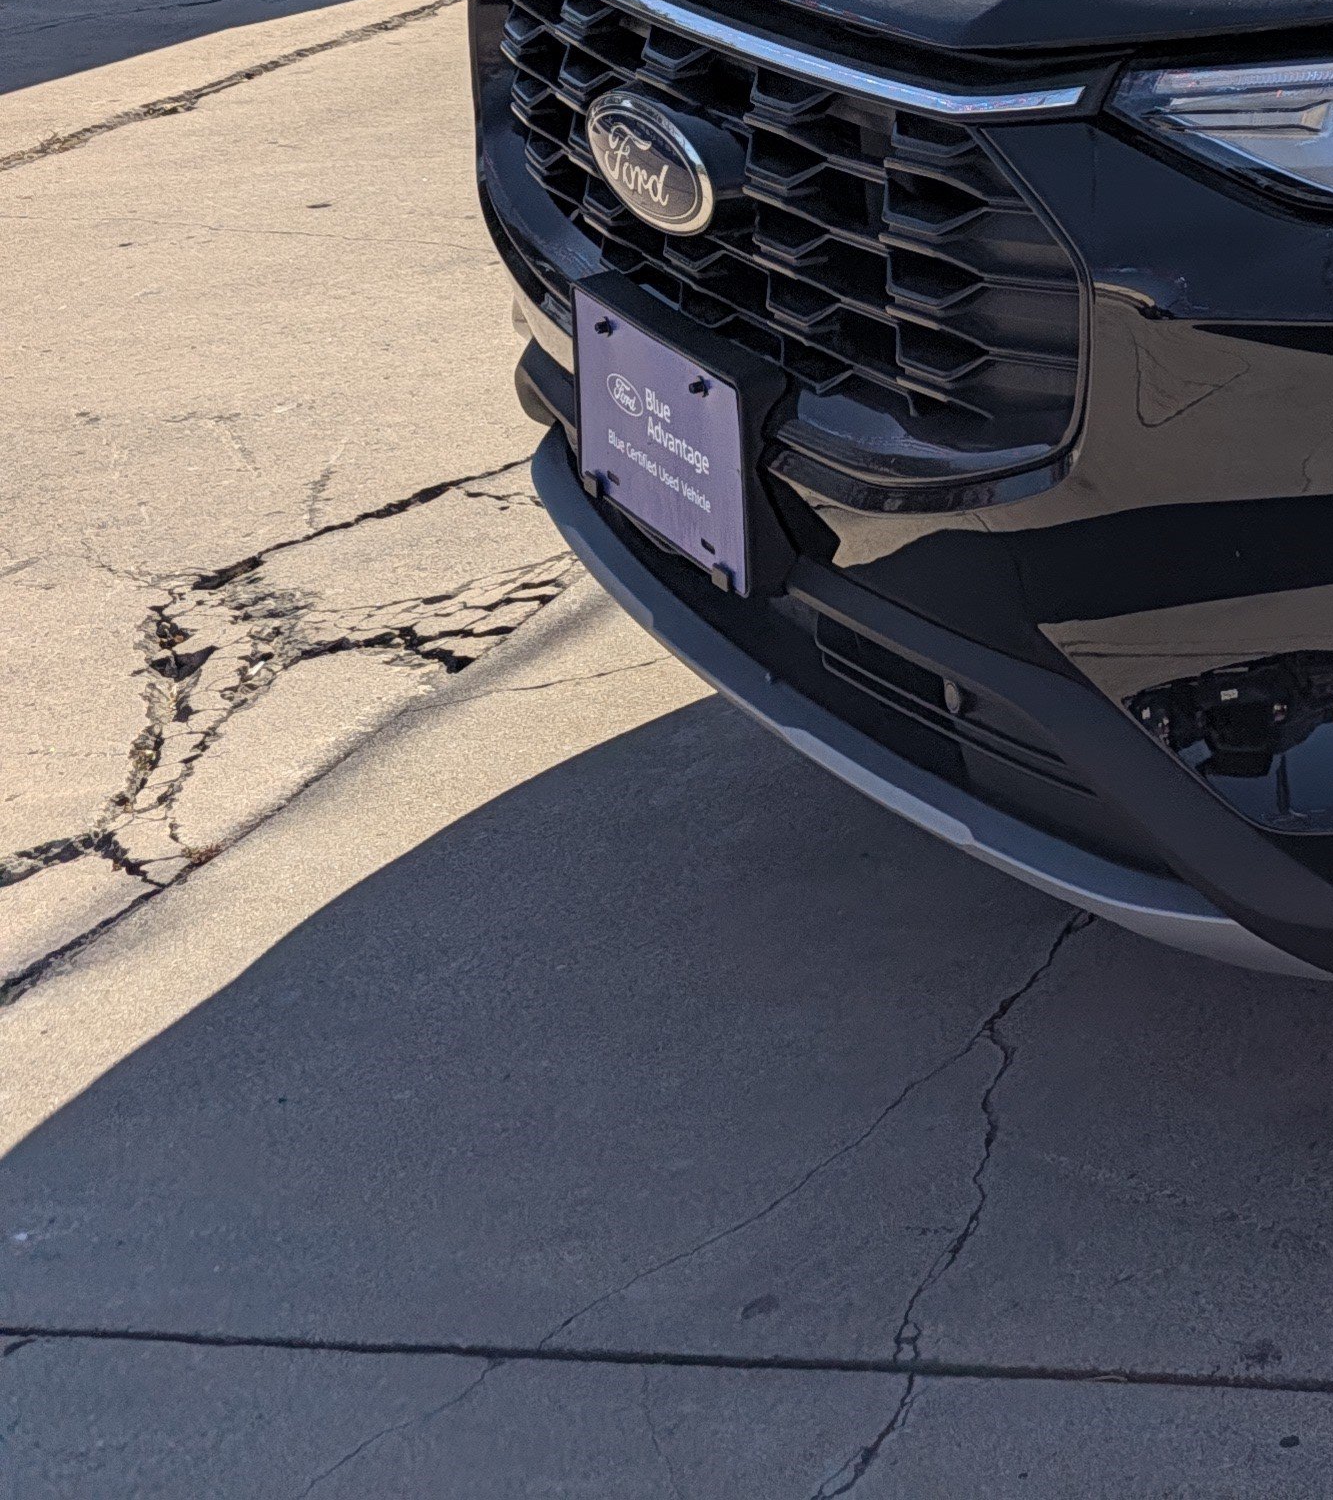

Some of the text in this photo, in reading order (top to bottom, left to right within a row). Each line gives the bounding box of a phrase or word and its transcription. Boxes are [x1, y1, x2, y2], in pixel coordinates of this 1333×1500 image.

[604, 123, 670, 206] Ford
[613, 377, 638, 414] Ford
[645, 387, 671, 423] Blue
[608, 429, 712, 513] Blue Certified Used Vehicle
[647, 416, 710, 475] Advantage
